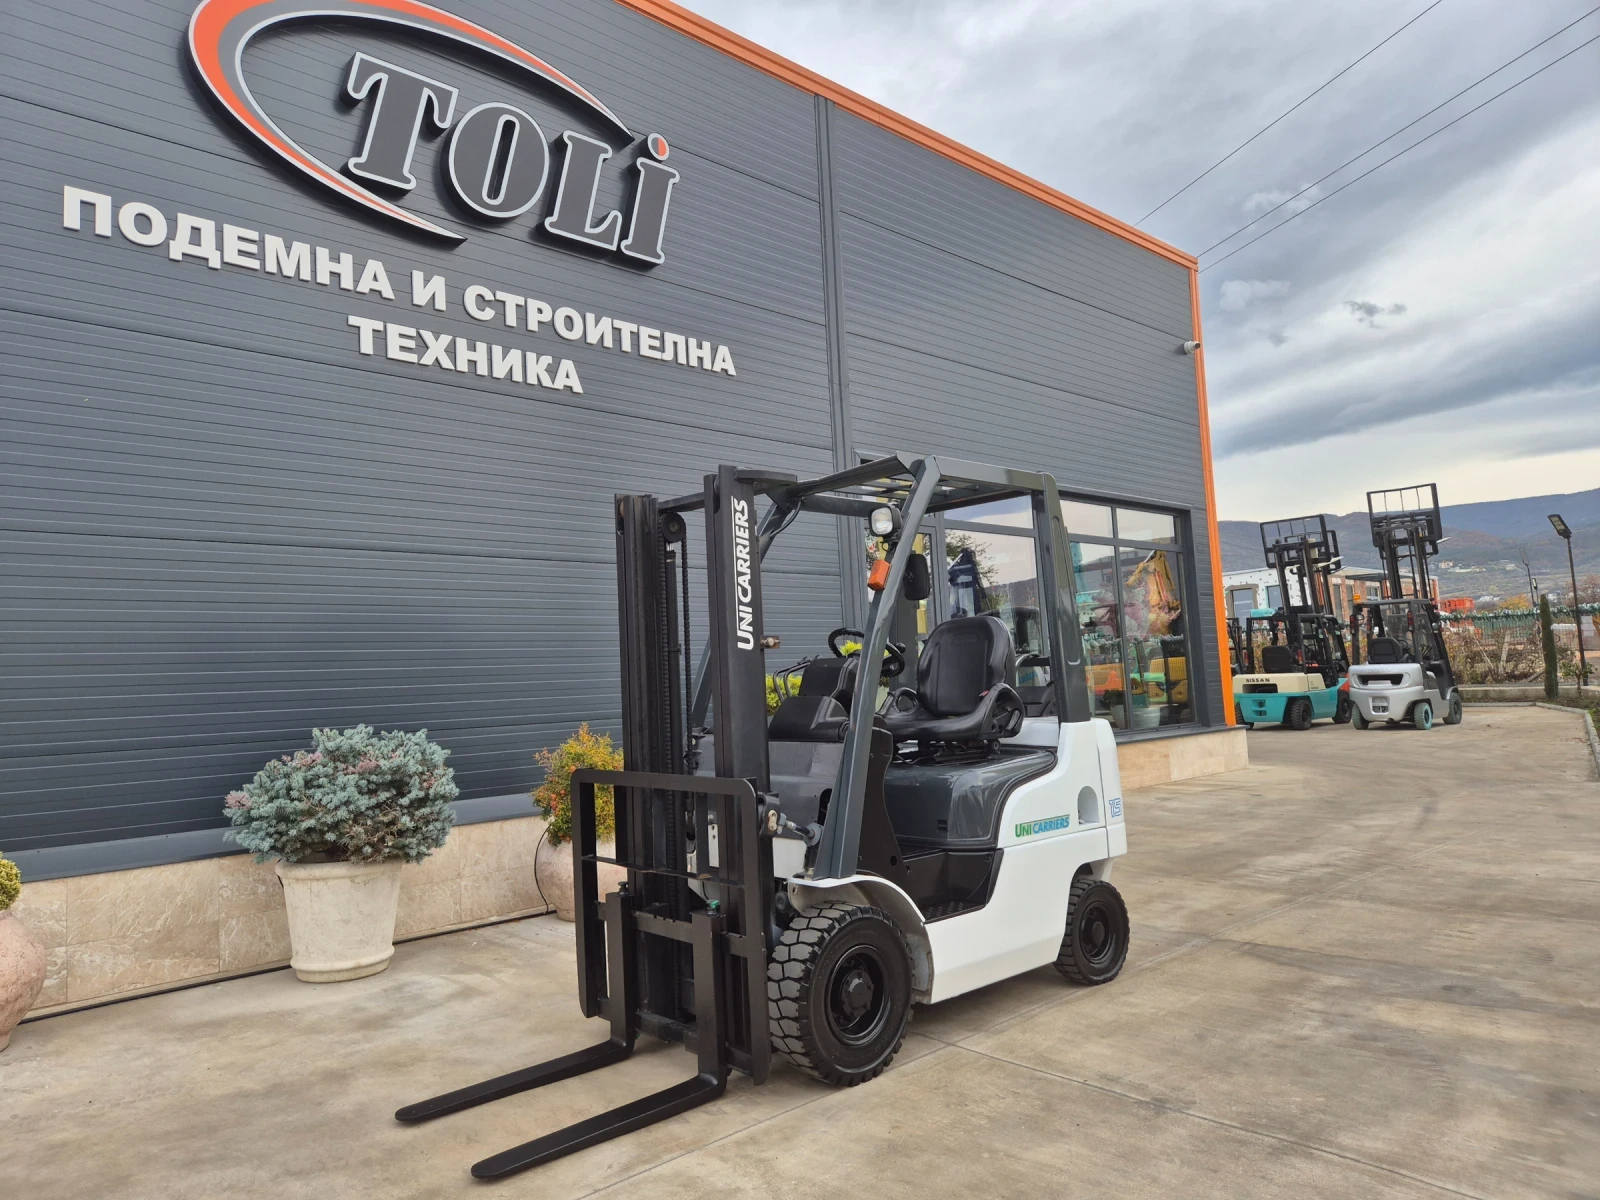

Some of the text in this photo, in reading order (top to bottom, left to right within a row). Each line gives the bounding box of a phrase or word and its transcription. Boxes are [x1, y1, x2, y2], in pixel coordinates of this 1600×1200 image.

[63, 185, 737, 376] ПОДЕМНА И СТРОИТЕЛНА
[347, 315, 584, 394] ТЕХНИКА
[1109, 797, 1122, 818] 15
